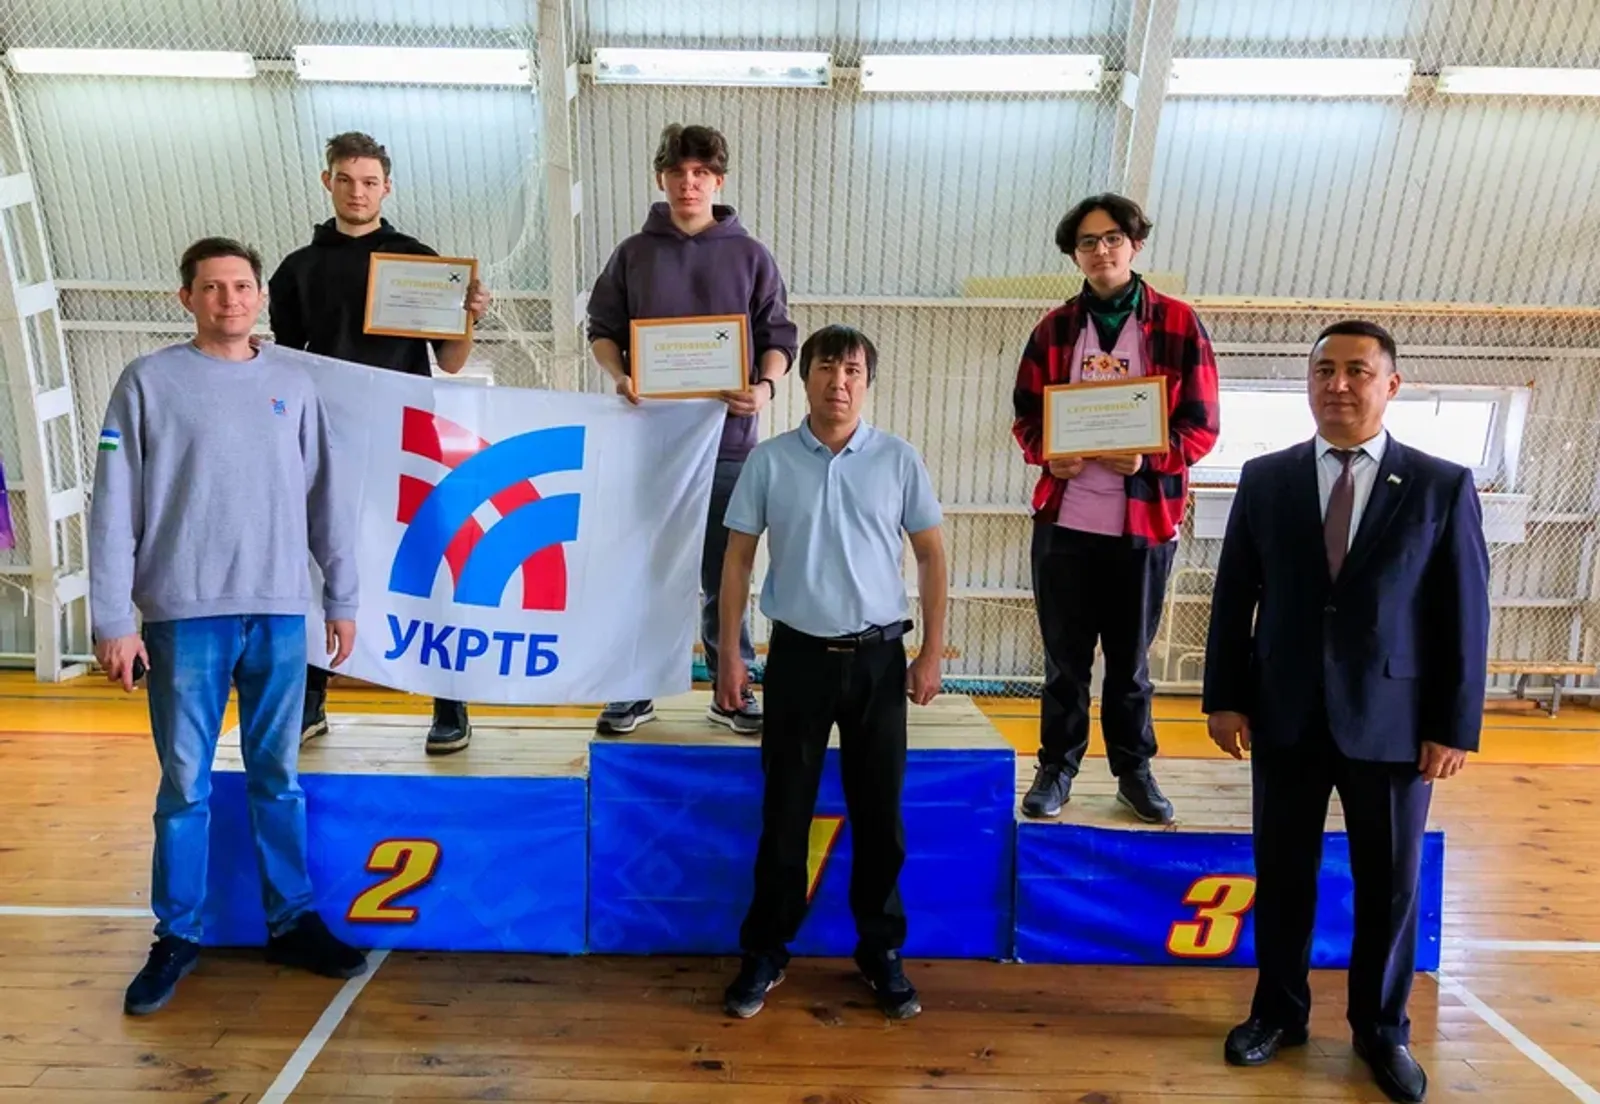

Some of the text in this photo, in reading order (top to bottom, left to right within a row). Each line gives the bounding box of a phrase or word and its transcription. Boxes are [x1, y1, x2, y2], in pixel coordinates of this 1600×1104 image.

[384, 613, 559, 677] УКРТБ
[347, 838, 441, 922] 2
[1166, 875, 1257, 958] 3
